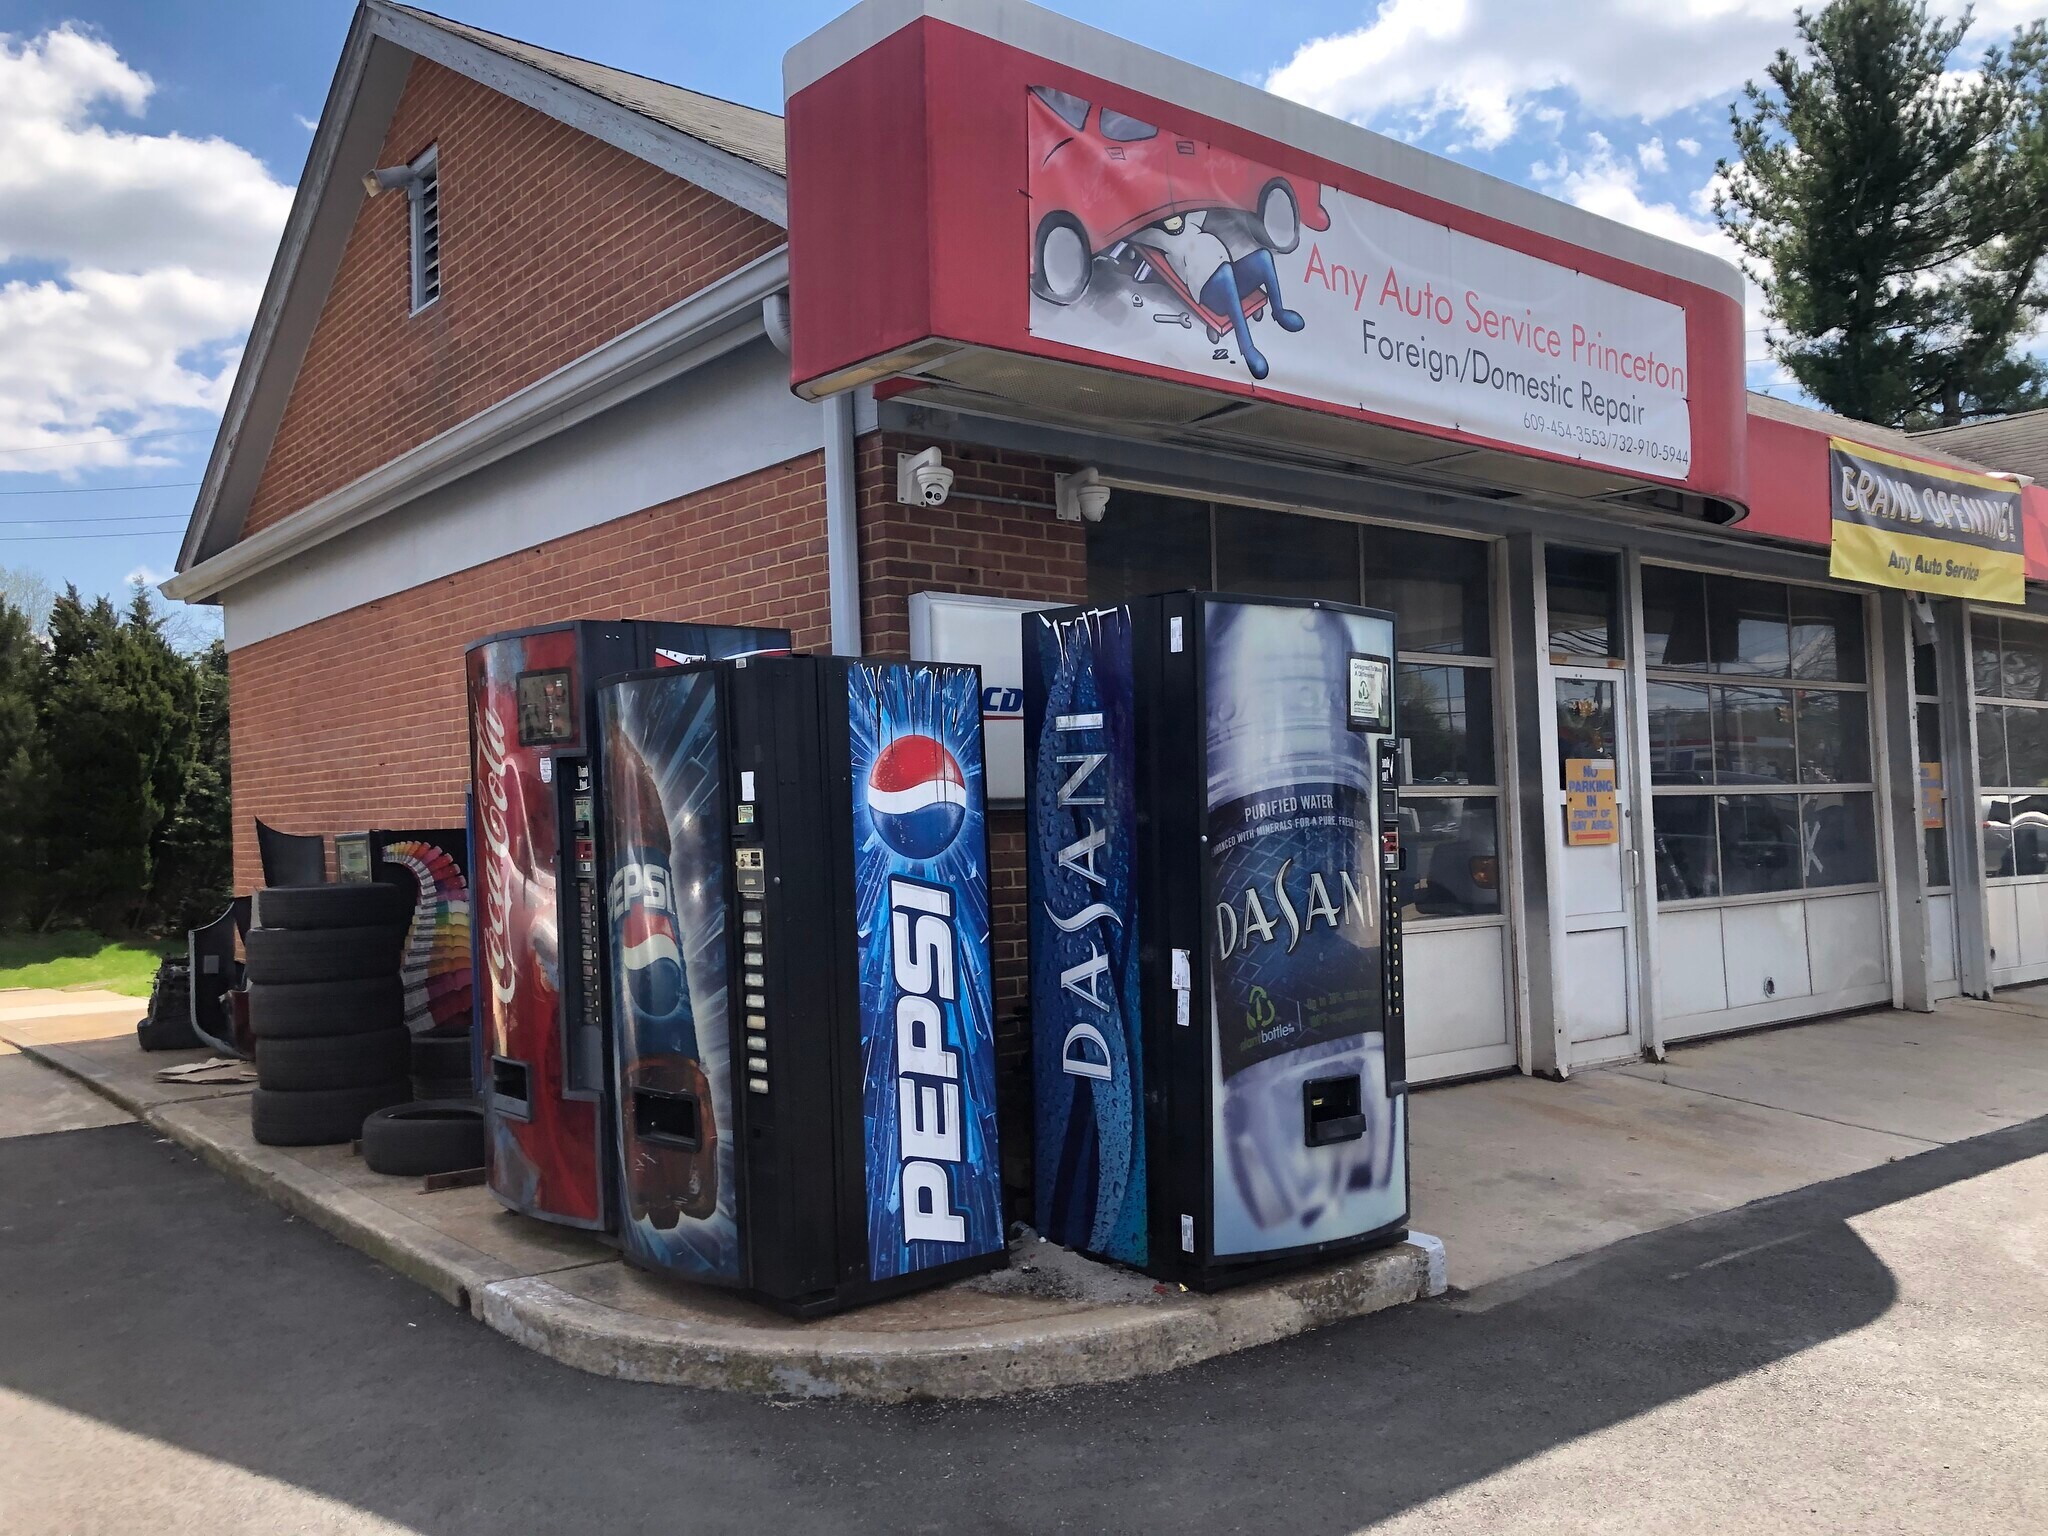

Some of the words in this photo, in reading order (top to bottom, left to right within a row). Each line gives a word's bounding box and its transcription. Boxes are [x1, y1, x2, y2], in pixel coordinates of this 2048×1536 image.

[1304, 243, 1368, 311] Any
[1379, 266, 1453, 325] Auto
[1465, 291, 1561, 357] Service
[1572, 324, 1685, 391] Princeton
[1363, 320, 1573, 409] Foreign/Domestic
[1581, 381, 1644, 426] Repair
[1523, 411, 1689, 466] 609-454-3553/732-910-5944
[1841, 466, 1923, 524] GRAND
[1922, 487, 2016, 543] OPENING!
[1888, 550, 1911, 575] Any
[1915, 554, 1942, 577] Auto
[1945, 559, 1980, 581] Service
[1569, 780, 1613, 792] PARKING
[1583, 765, 1598, 778] NO
[1244, 796, 1297, 822] PURIFIED
[1300, 794, 1334, 810] WATER
[1586, 795, 1597, 807] IN
[1600, 809, 1611, 818] OF
[1237, 829, 1254, 844] WITH
[1256, 821, 1292, 836] MINERALS
[1294, 817, 1310, 827] FOR
[1043, 712, 1123, 1082] DASANI
[1216, 858, 1374, 961] DASANI
[890, 878, 966, 1246] PEPSI
